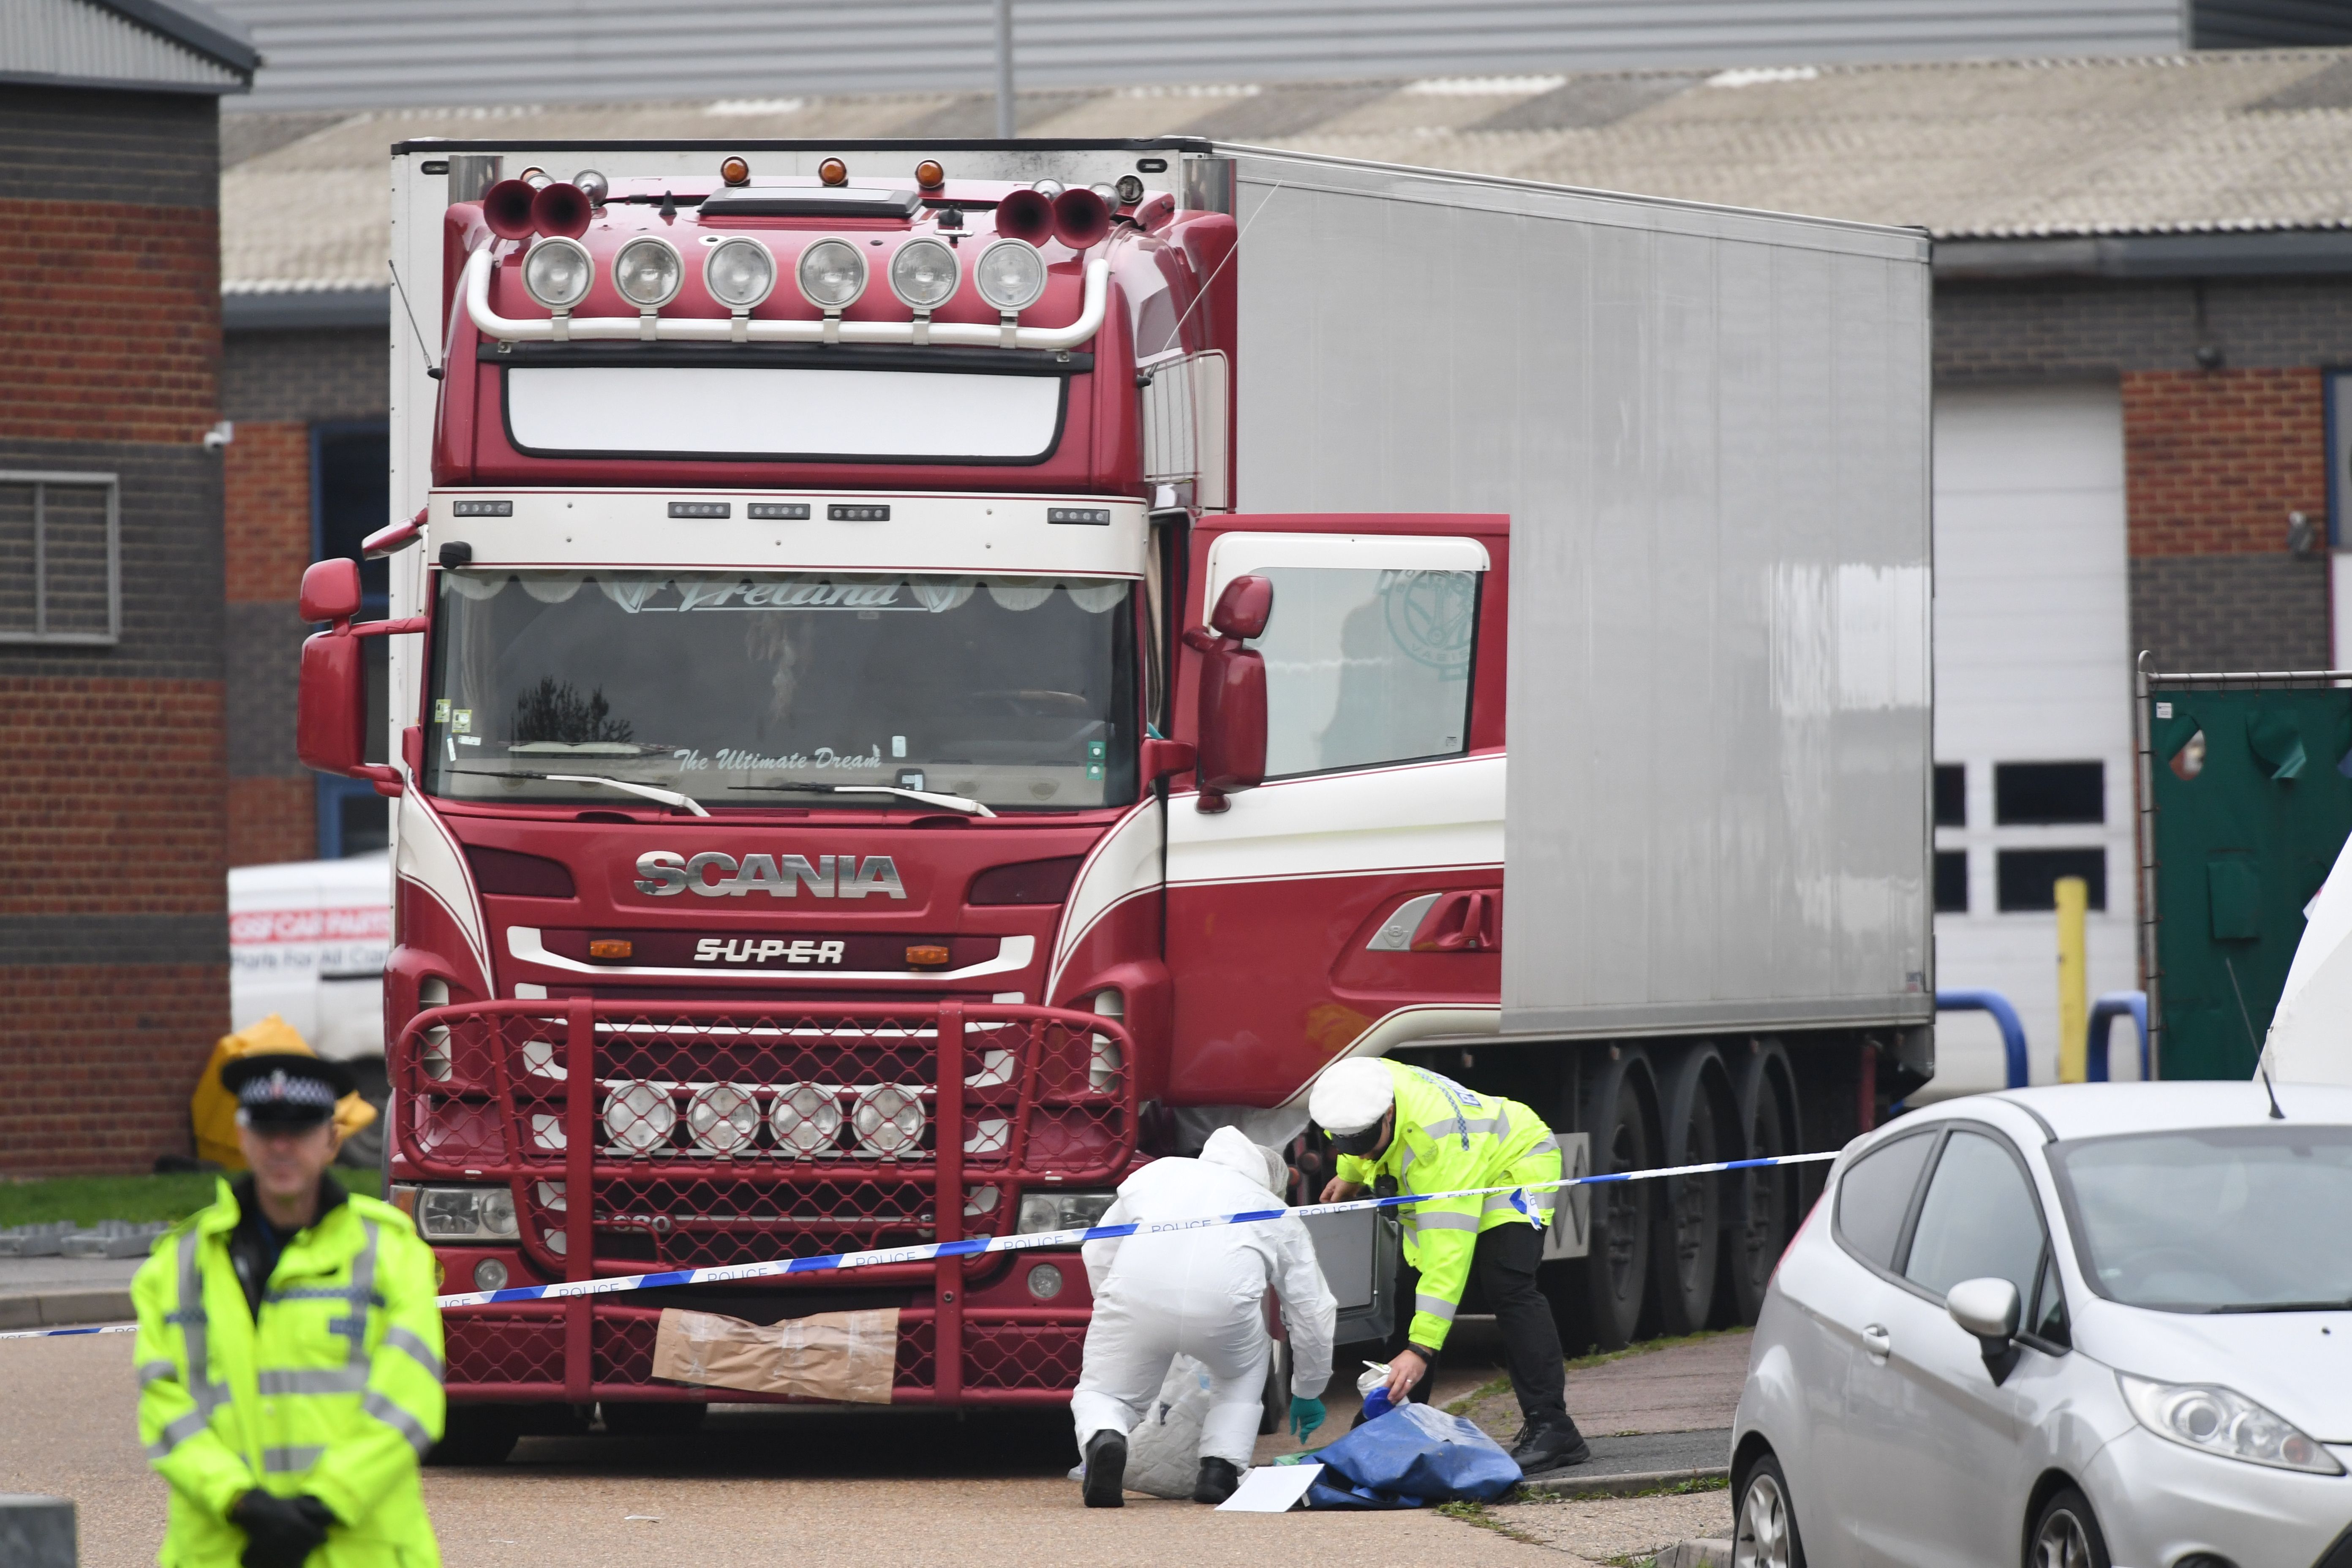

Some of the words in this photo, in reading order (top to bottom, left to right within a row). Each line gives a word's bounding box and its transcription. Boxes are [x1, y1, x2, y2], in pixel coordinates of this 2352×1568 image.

[674, 749, 708, 772] The
[716, 748, 807, 770] Ultimate
[814, 747, 881, 769] Dream
[634, 850, 908, 899] SCANIA
[694, 938, 845, 964] SUPER
